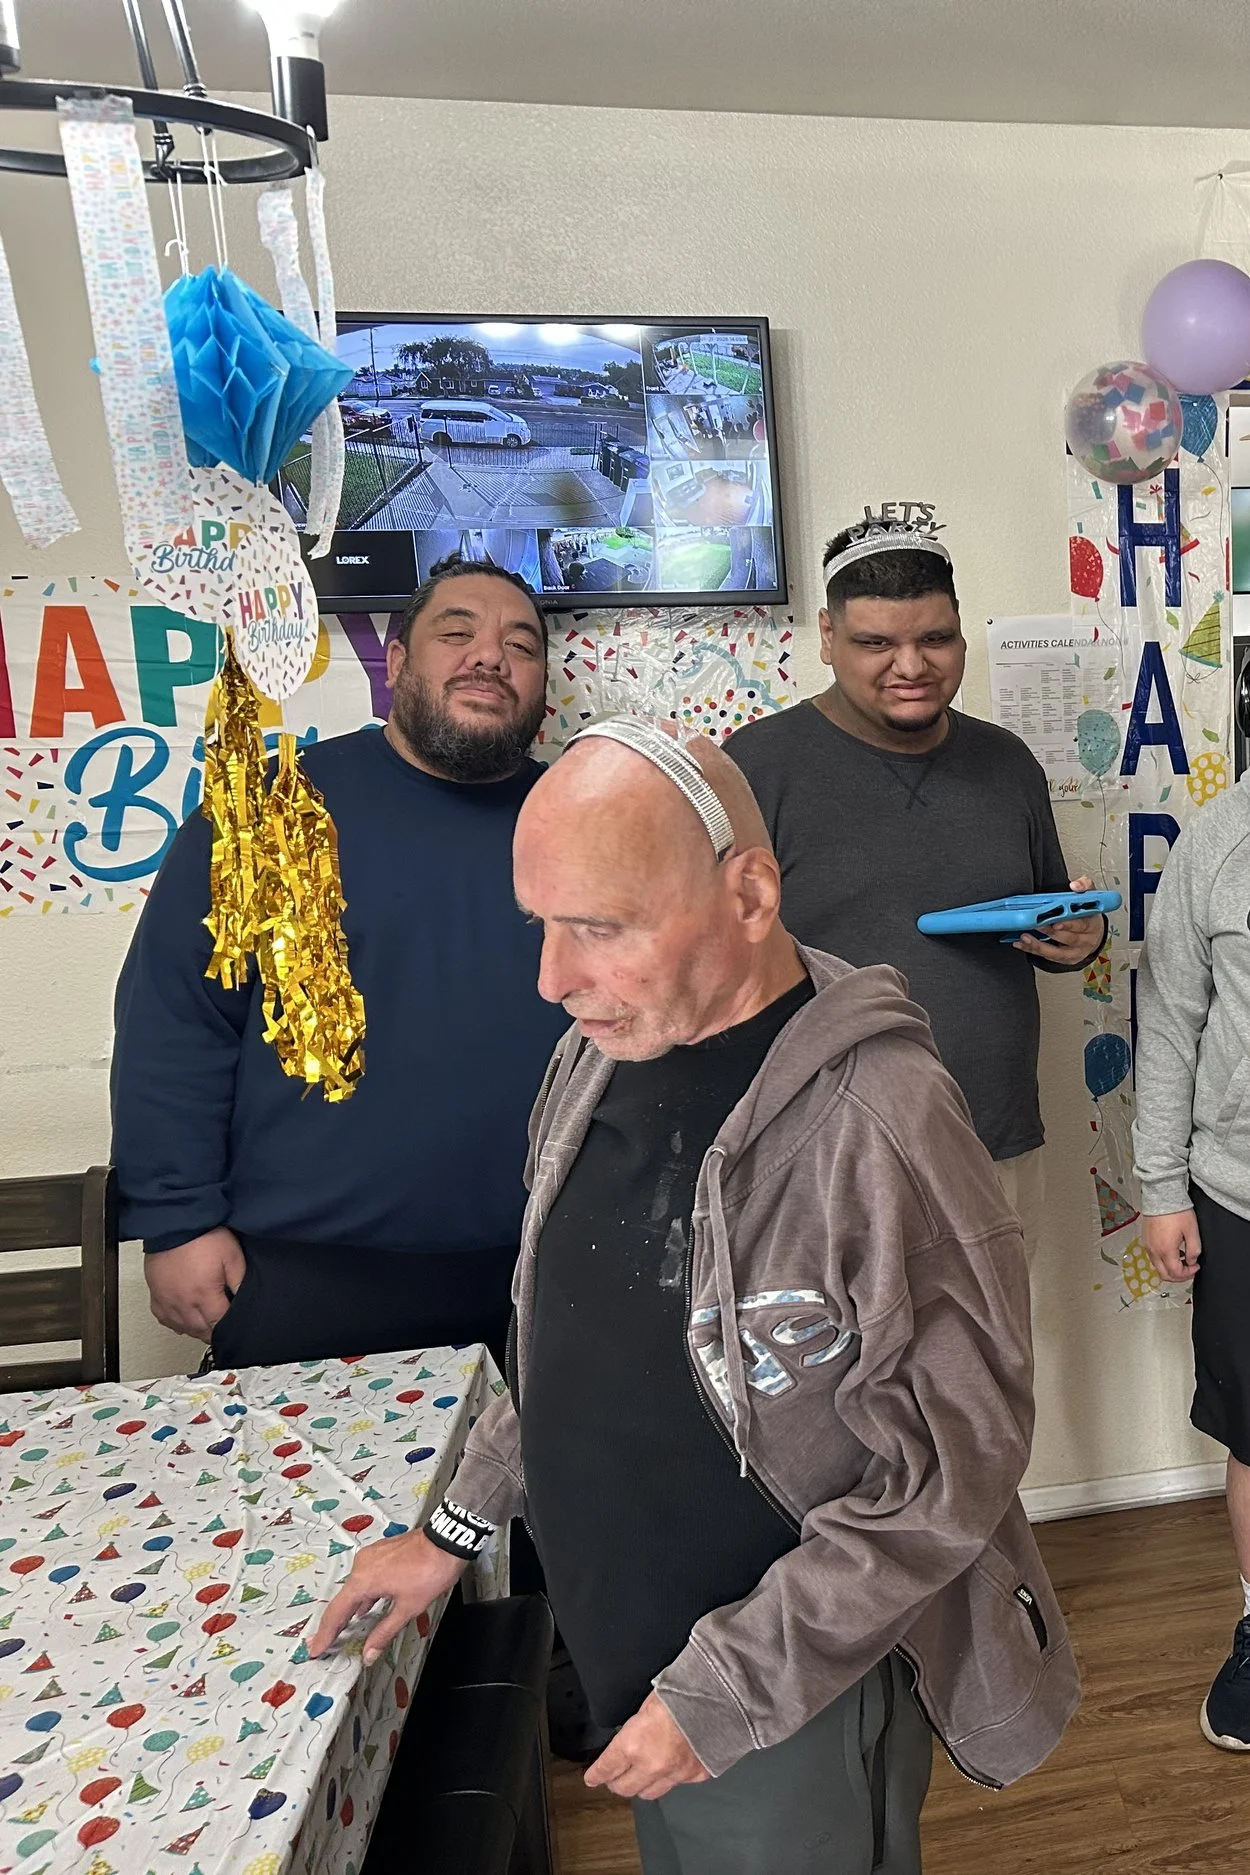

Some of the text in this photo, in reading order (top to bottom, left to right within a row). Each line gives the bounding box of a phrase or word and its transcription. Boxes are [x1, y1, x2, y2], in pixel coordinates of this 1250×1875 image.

[336, 556, 370, 565] LOREX
[238, 581, 304, 629] HAPPY
[248, 617, 310, 653] Birthday
[1001, 640, 1049, 649] ACTIVITIES
